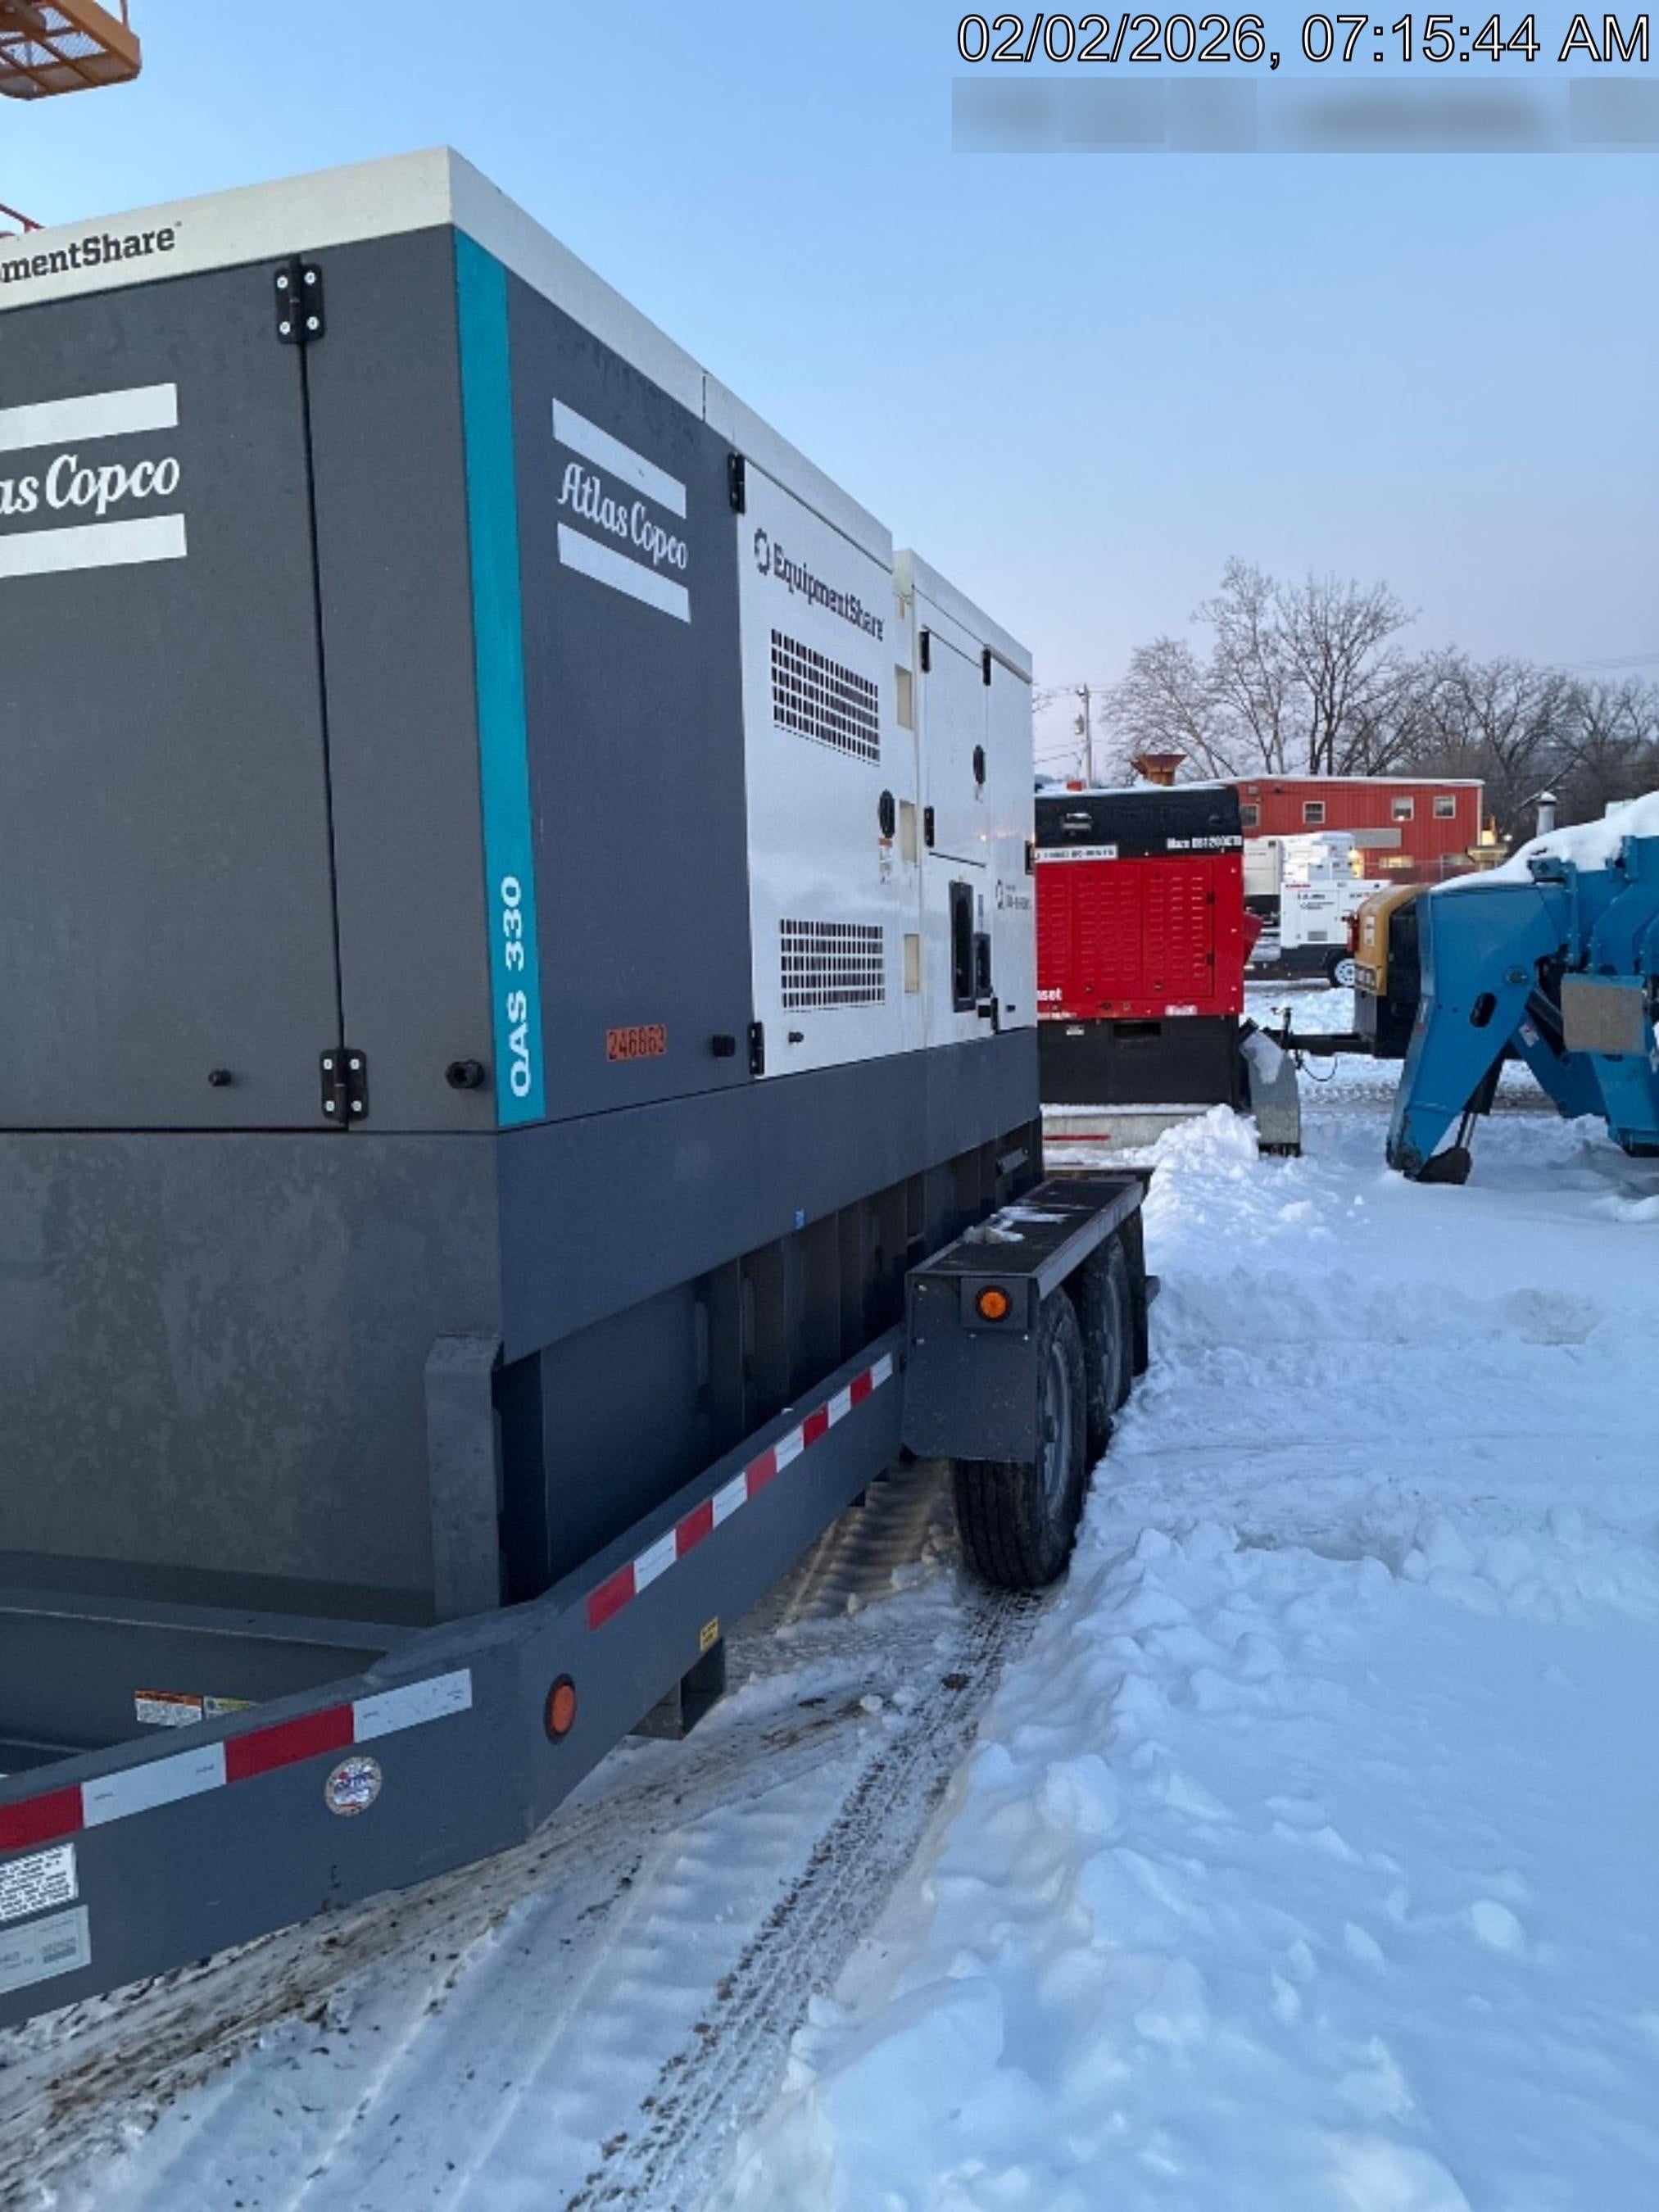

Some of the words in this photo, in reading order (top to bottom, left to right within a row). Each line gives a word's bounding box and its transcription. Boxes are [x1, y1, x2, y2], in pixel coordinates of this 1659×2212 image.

[0, 226, 175, 283] mentShare
[45, 454, 180, 515] Copco
[557, 462, 628, 537] Atlas
[630, 501, 689, 570] Copco
[773, 542, 884, 642] EquipmentShare
[501, 875, 524, 972] 330
